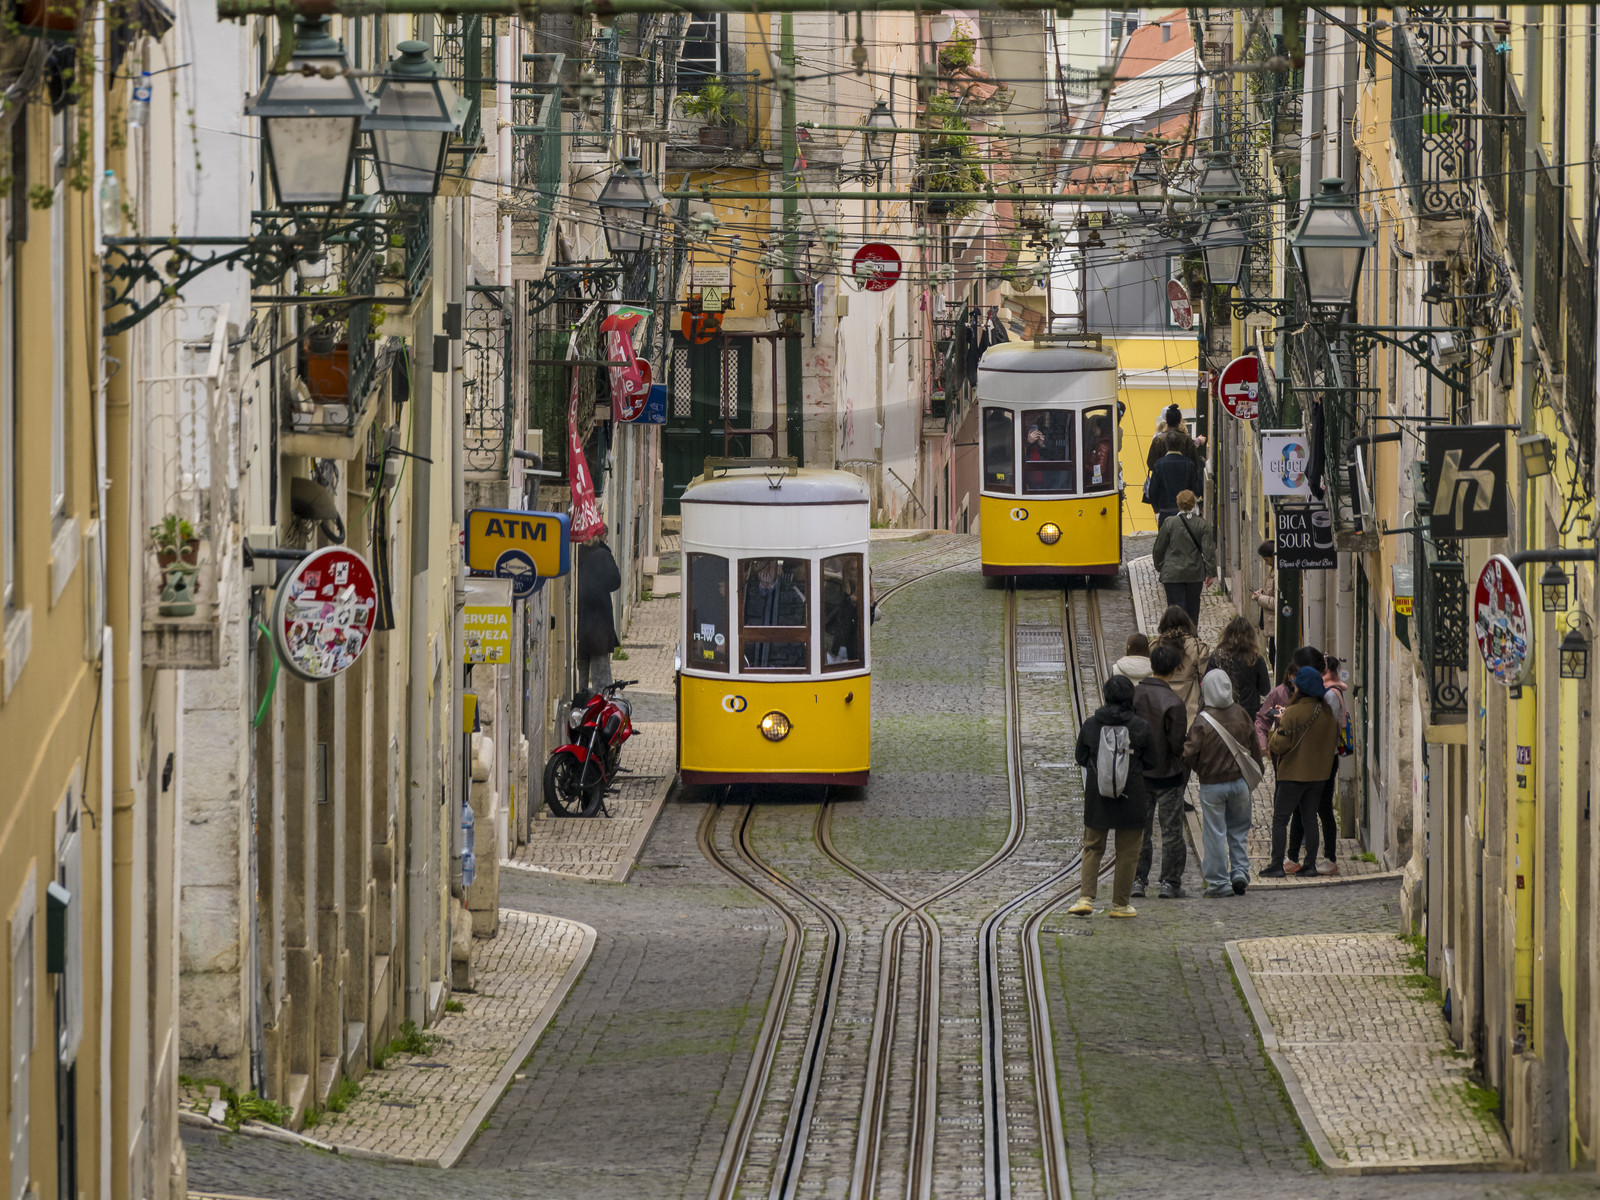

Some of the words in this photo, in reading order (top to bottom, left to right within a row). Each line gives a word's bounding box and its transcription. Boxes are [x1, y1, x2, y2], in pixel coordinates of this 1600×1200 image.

[1078, 509, 1083, 517] 2
[1279, 514, 1307, 530] BICA
[485, 518, 547, 542] ATM
[1279, 532, 1311, 548] SOUR
[1322, 558, 1333, 567] Bar
[814, 694, 818, 704] 1
